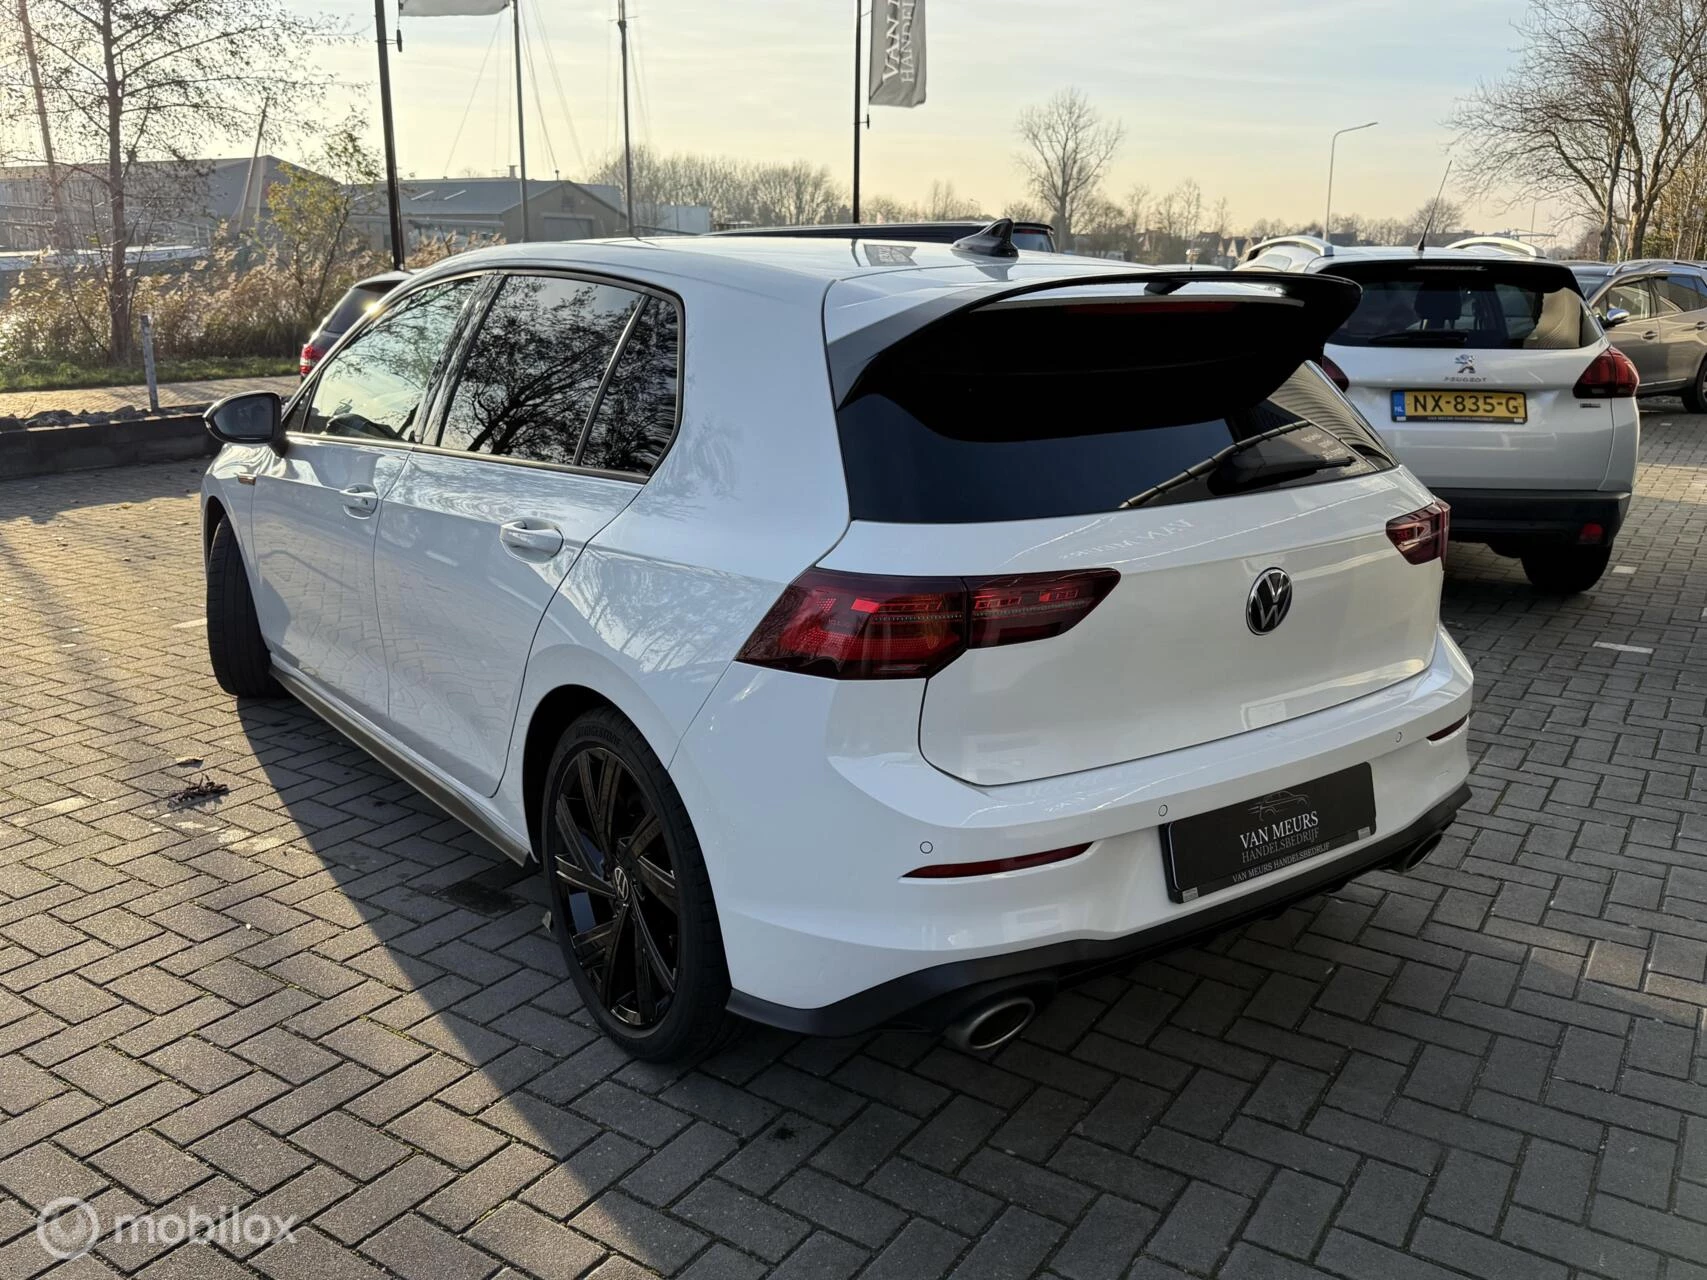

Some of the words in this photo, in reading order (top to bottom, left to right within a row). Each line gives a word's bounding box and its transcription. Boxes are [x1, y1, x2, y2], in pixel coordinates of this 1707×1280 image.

[882, 15, 900, 81] VAN
[1413, 394, 1519, 414] NX-835-G
[1239, 826, 1269, 849] VAN
[1271, 810, 1319, 840] MEURS
[1242, 827, 1320, 863] HANDELSBEDRIJF
[1232, 872, 1247, 883] VAN
[1248, 862, 1273, 877] MEURS
